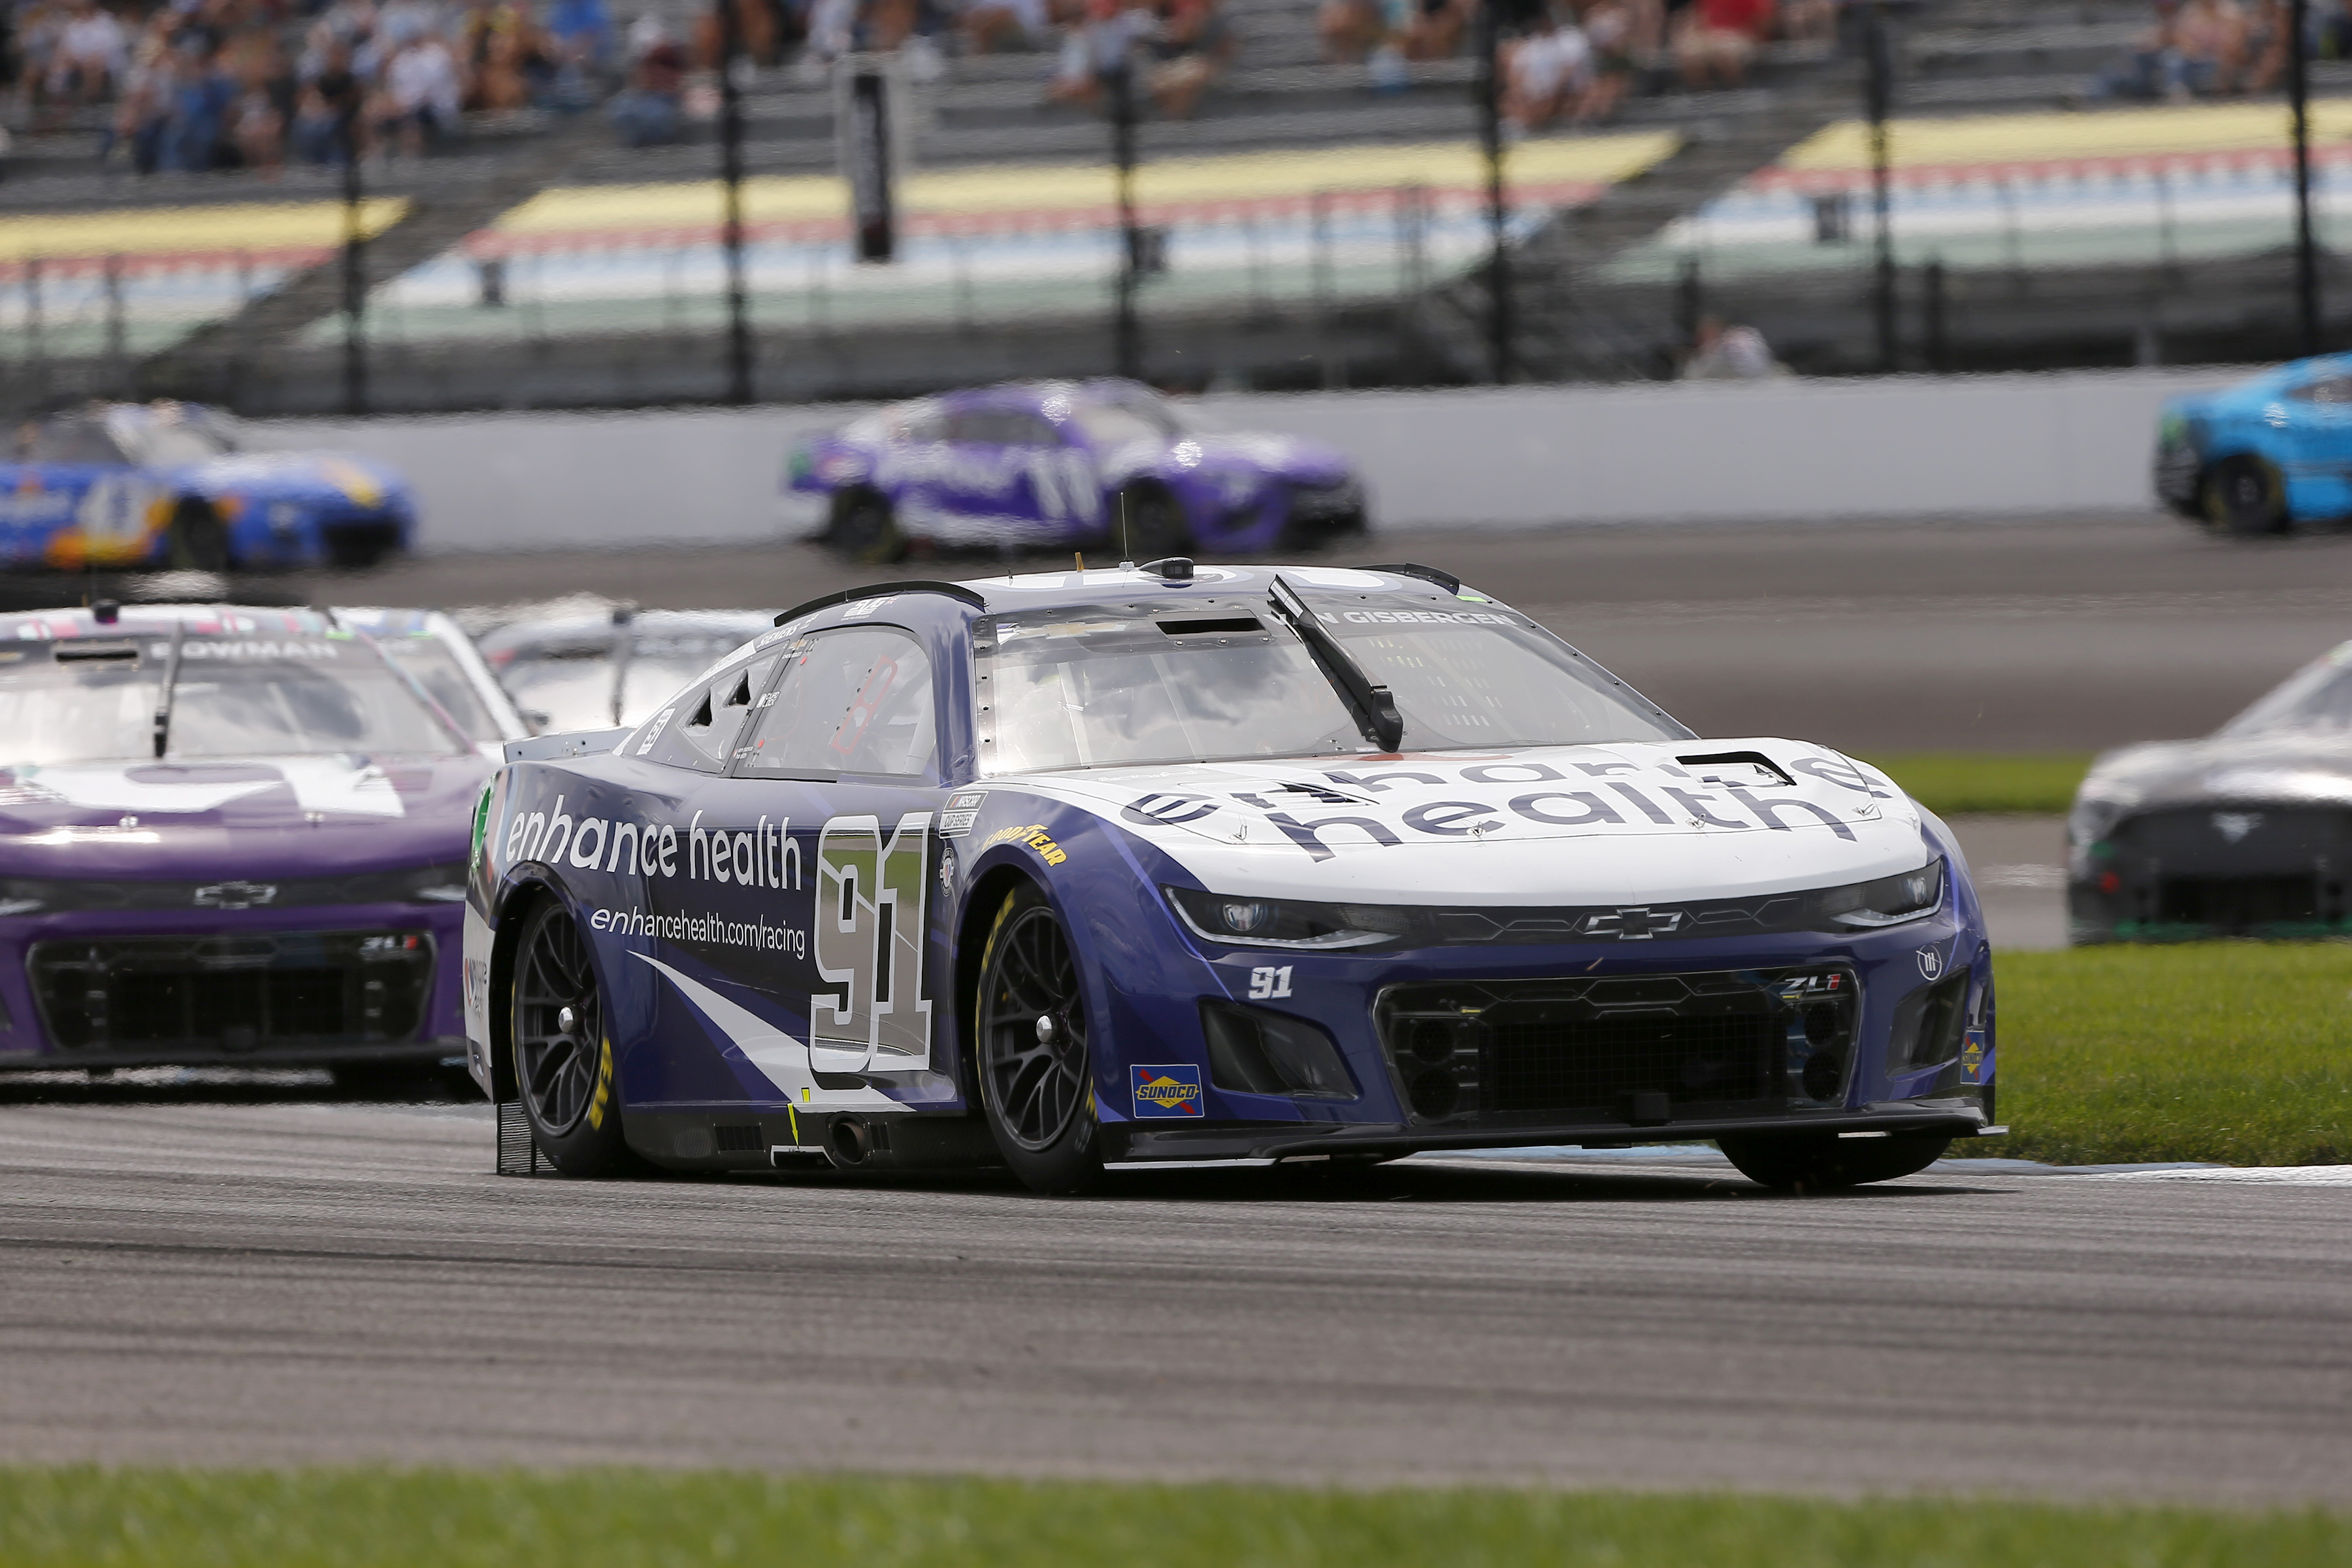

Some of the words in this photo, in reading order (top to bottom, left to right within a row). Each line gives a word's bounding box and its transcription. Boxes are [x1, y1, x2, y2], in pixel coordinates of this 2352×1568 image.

[757, 623, 801, 648] SIEMENS
[1263, 612, 1340, 626] VN
[1343, 611, 1518, 626] GISBERGEN
[955, 794, 981, 808] NASCAR
[1120, 757, 1894, 826] ehane
[1264, 781, 1858, 862] health
[506, 794, 678, 877] enhance
[689, 809, 802, 890] health
[981, 824, 1068, 867] GOODYEAR
[590, 907, 805, 960] enhancehealth.com/racing
[809, 811, 933, 1073] 91
[1248, 965, 1294, 1000] 91
[1779, 973, 1841, 995] ZL1
[1139, 1085, 1198, 1099] SUNOCO
